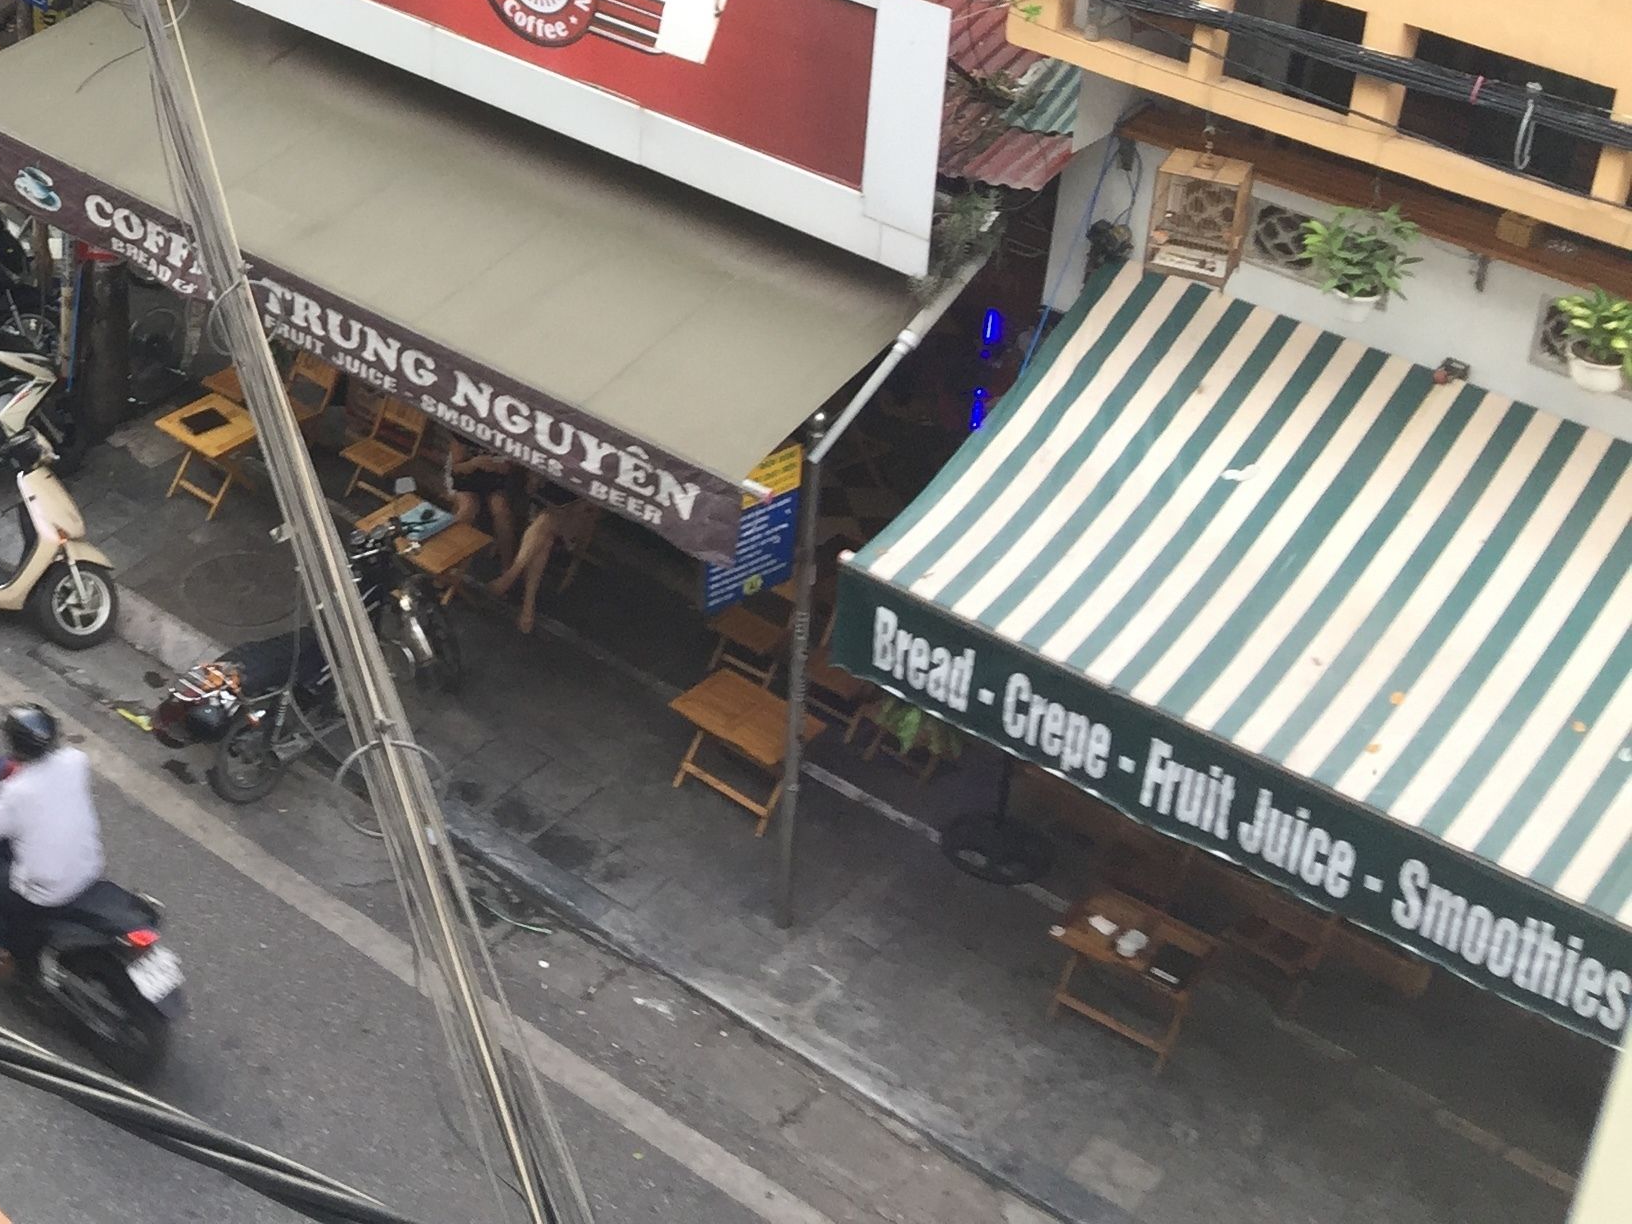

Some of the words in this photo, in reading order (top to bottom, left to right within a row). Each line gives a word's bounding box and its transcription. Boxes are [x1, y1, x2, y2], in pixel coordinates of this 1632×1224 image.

[83, 194, 208, 276] COFF
[261, 277, 439, 387] TRUNG
[110, 237, 172, 282] BREAD
[264, 313, 325, 355] FRUIT
[331, 351, 398, 394] JUICE
[419, 394, 564, 477] SMOOTHIES
[588, 480, 663, 525] BEER
[872, 605, 976, 712] Bread
[977, 687, 995, 705] -
[1002, 672, 1112, 779] Crepe
[1118, 755, 1135, 774] -
[1138, 737, 1237, 841] Fruit
[1237, 788, 1357, 899] Juice
[1364, 874, 1384, 893] -
[1391, 859, 1631, 1031] Smoothies
